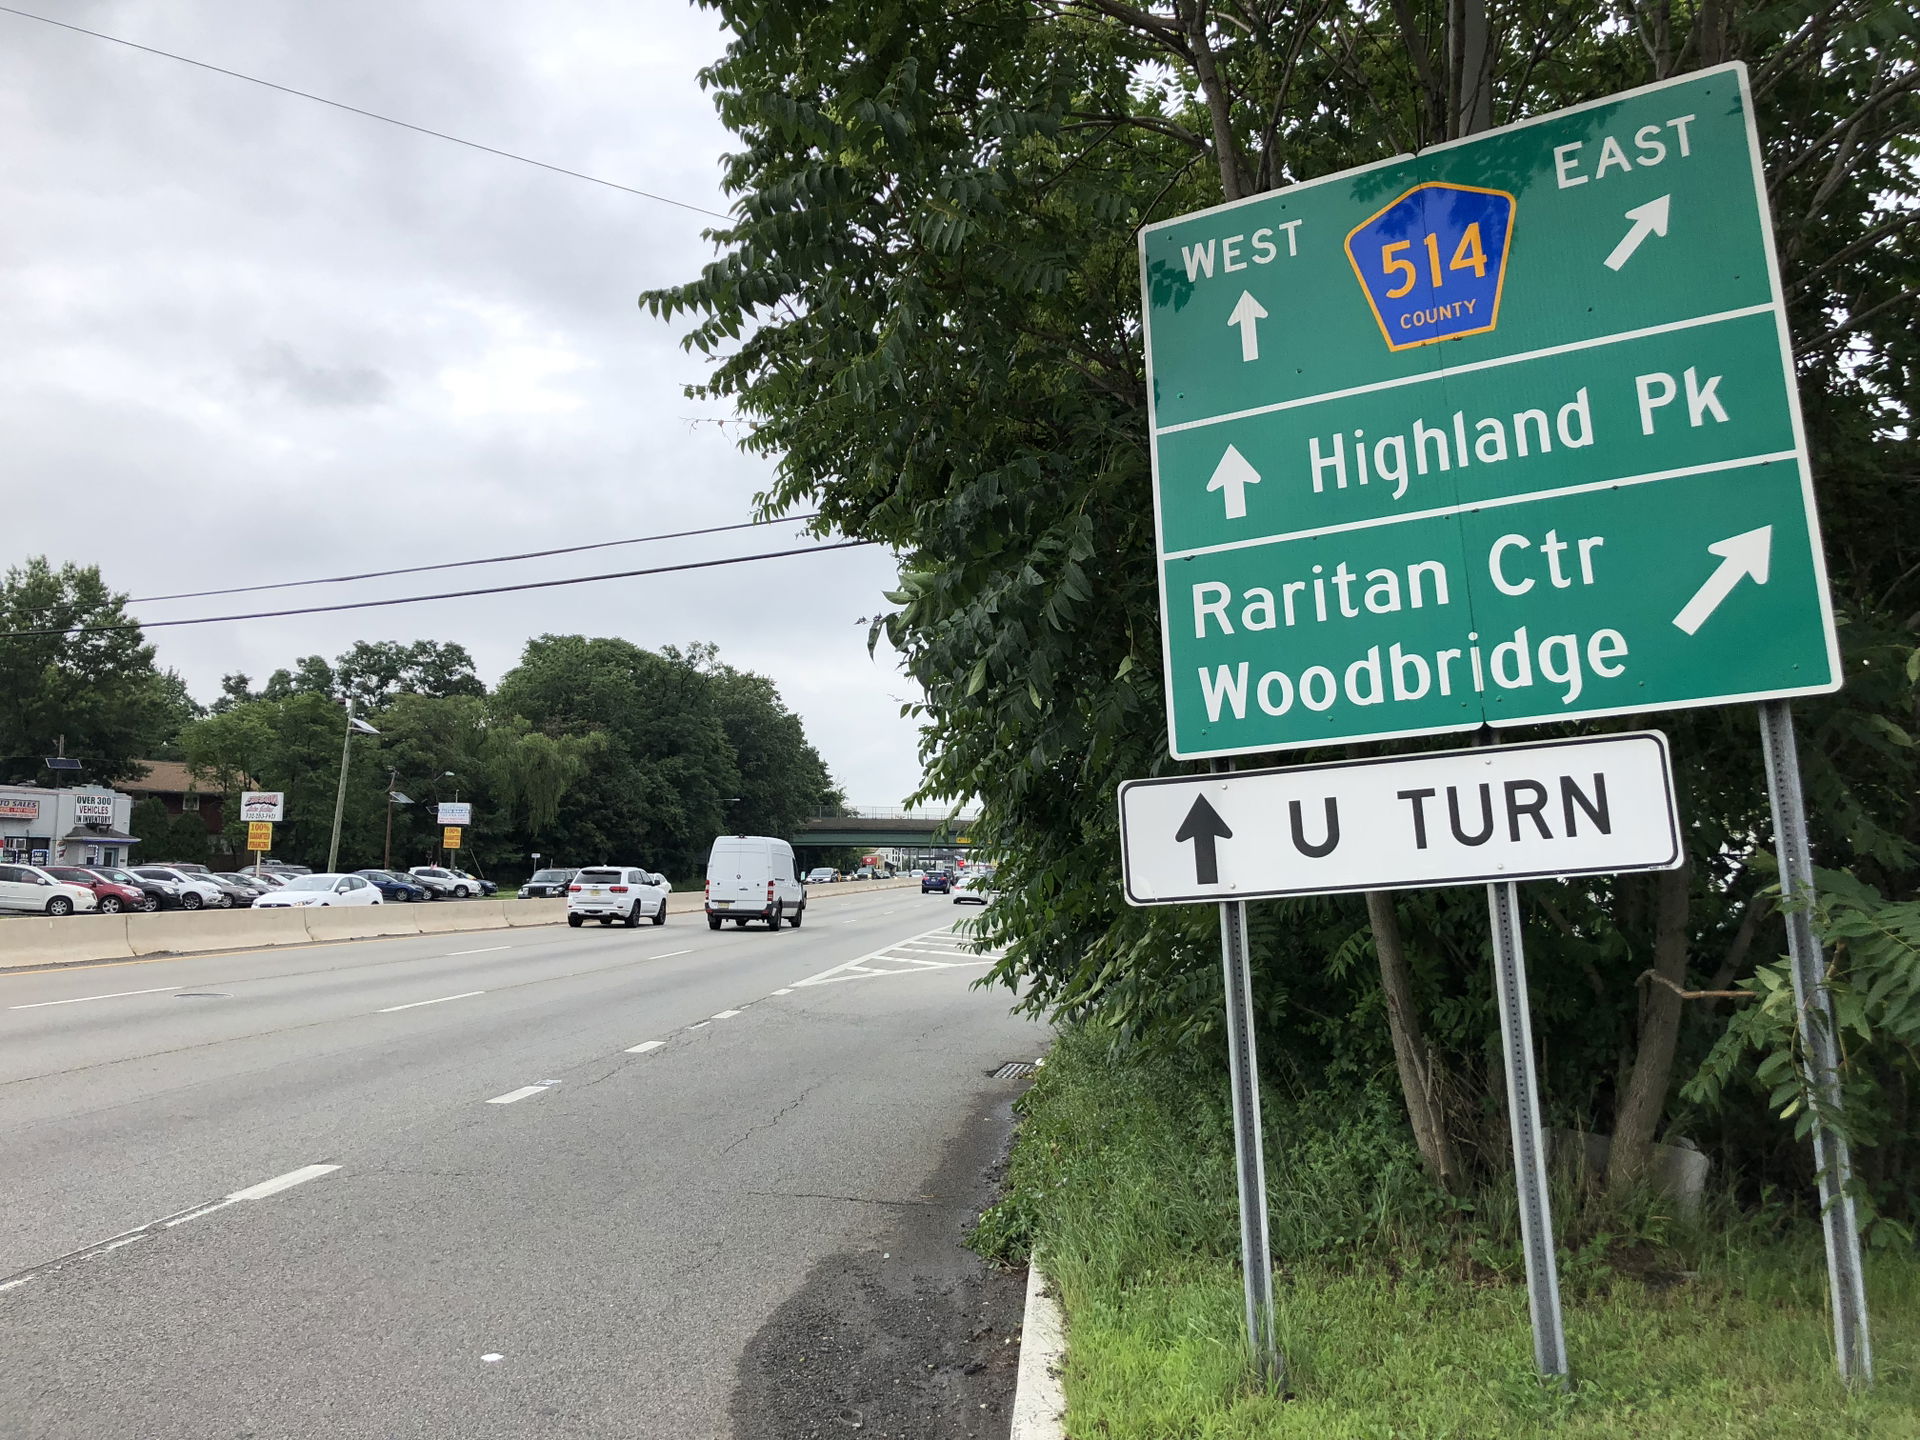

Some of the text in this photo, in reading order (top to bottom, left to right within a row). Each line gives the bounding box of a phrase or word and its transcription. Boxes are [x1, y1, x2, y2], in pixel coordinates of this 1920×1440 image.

[1554, 114, 1695, 189] EAST
[1182, 218, 1303, 281] WEST
[1382, 222, 1488, 298] 514
[1400, 299, 1477, 329] COUNTY
[1309, 366, 1729, 500] Highland Pk
[1192, 530, 1604, 639] Raritan Ctr
[1197, 626, 1629, 723] Woodbridge
[12, 800, 37, 808] SALES
[77, 796, 112, 805] OVER 300
[79, 805, 109, 814] VEHICLES
[83, 815, 111, 823] INVENTORY
[1289, 772, 1612, 859] U TURN
